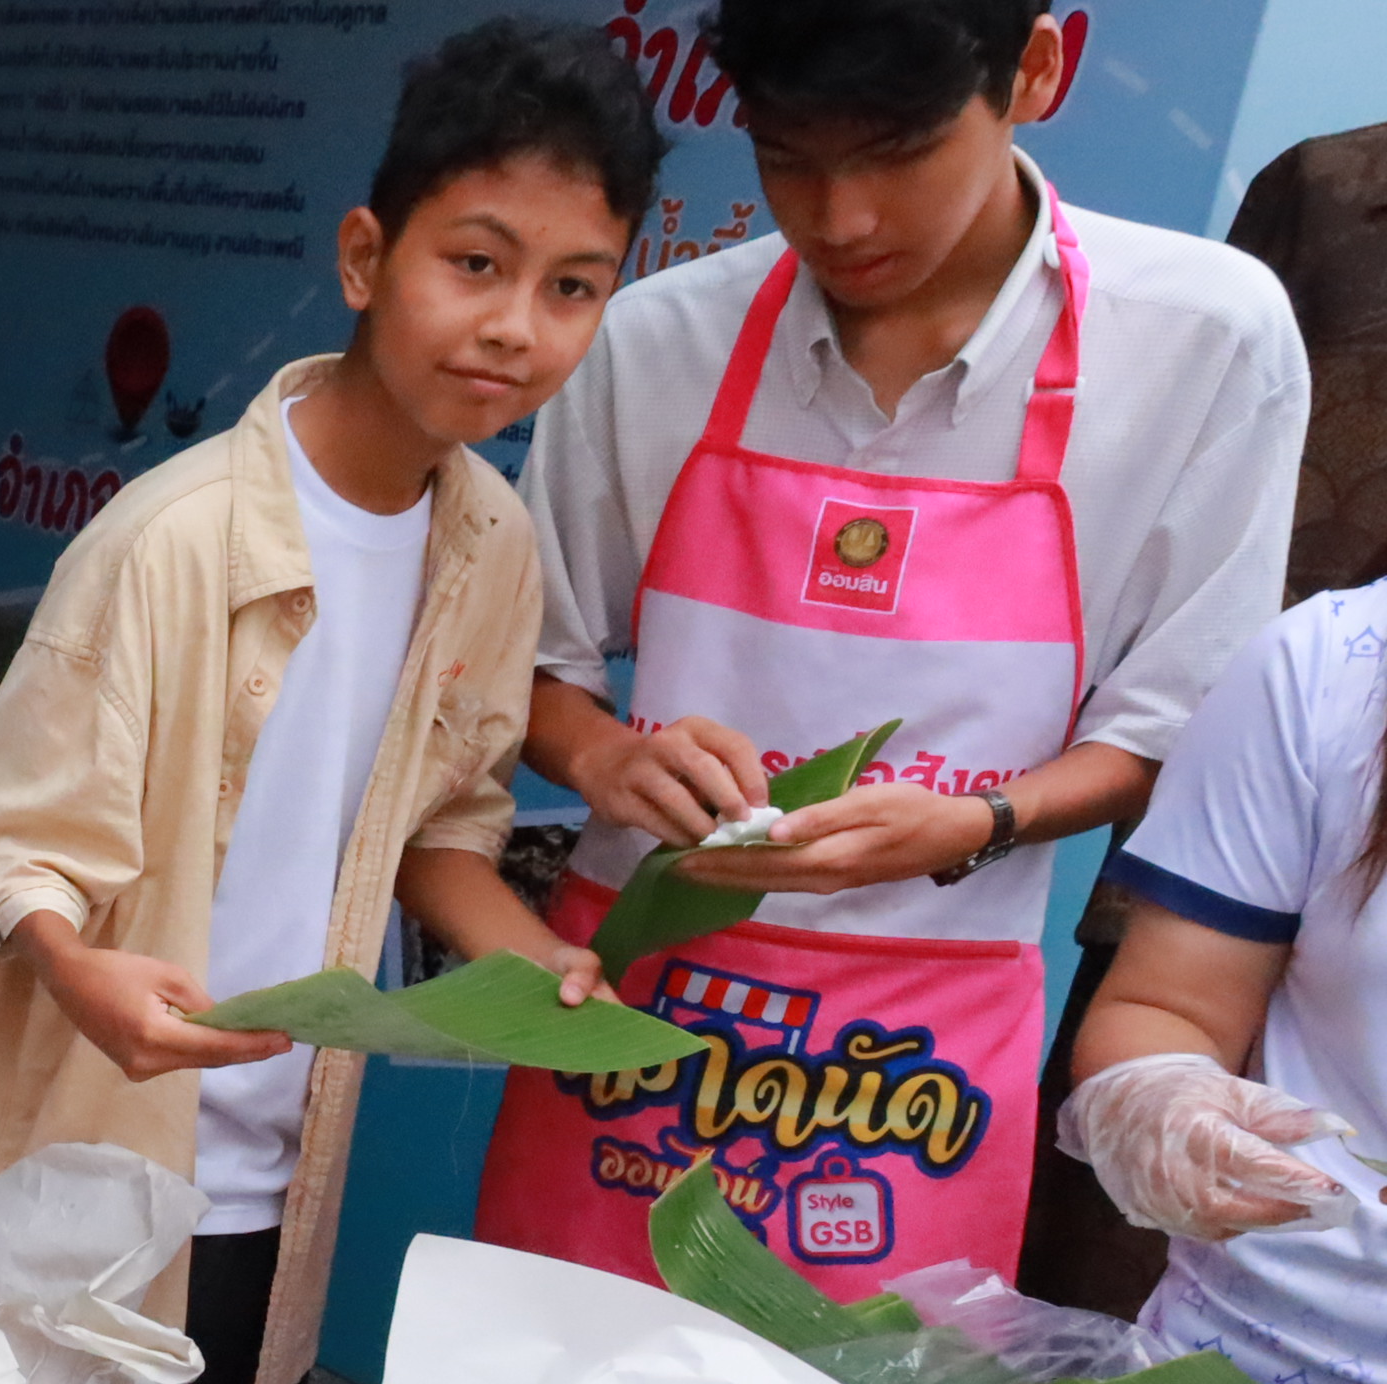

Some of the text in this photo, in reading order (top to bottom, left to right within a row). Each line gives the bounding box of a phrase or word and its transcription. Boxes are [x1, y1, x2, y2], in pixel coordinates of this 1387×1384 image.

[818, 571, 888, 594] ออมสิน
[807, 1193, 854, 1212] Style
[810, 1220, 874, 1246] GSB
